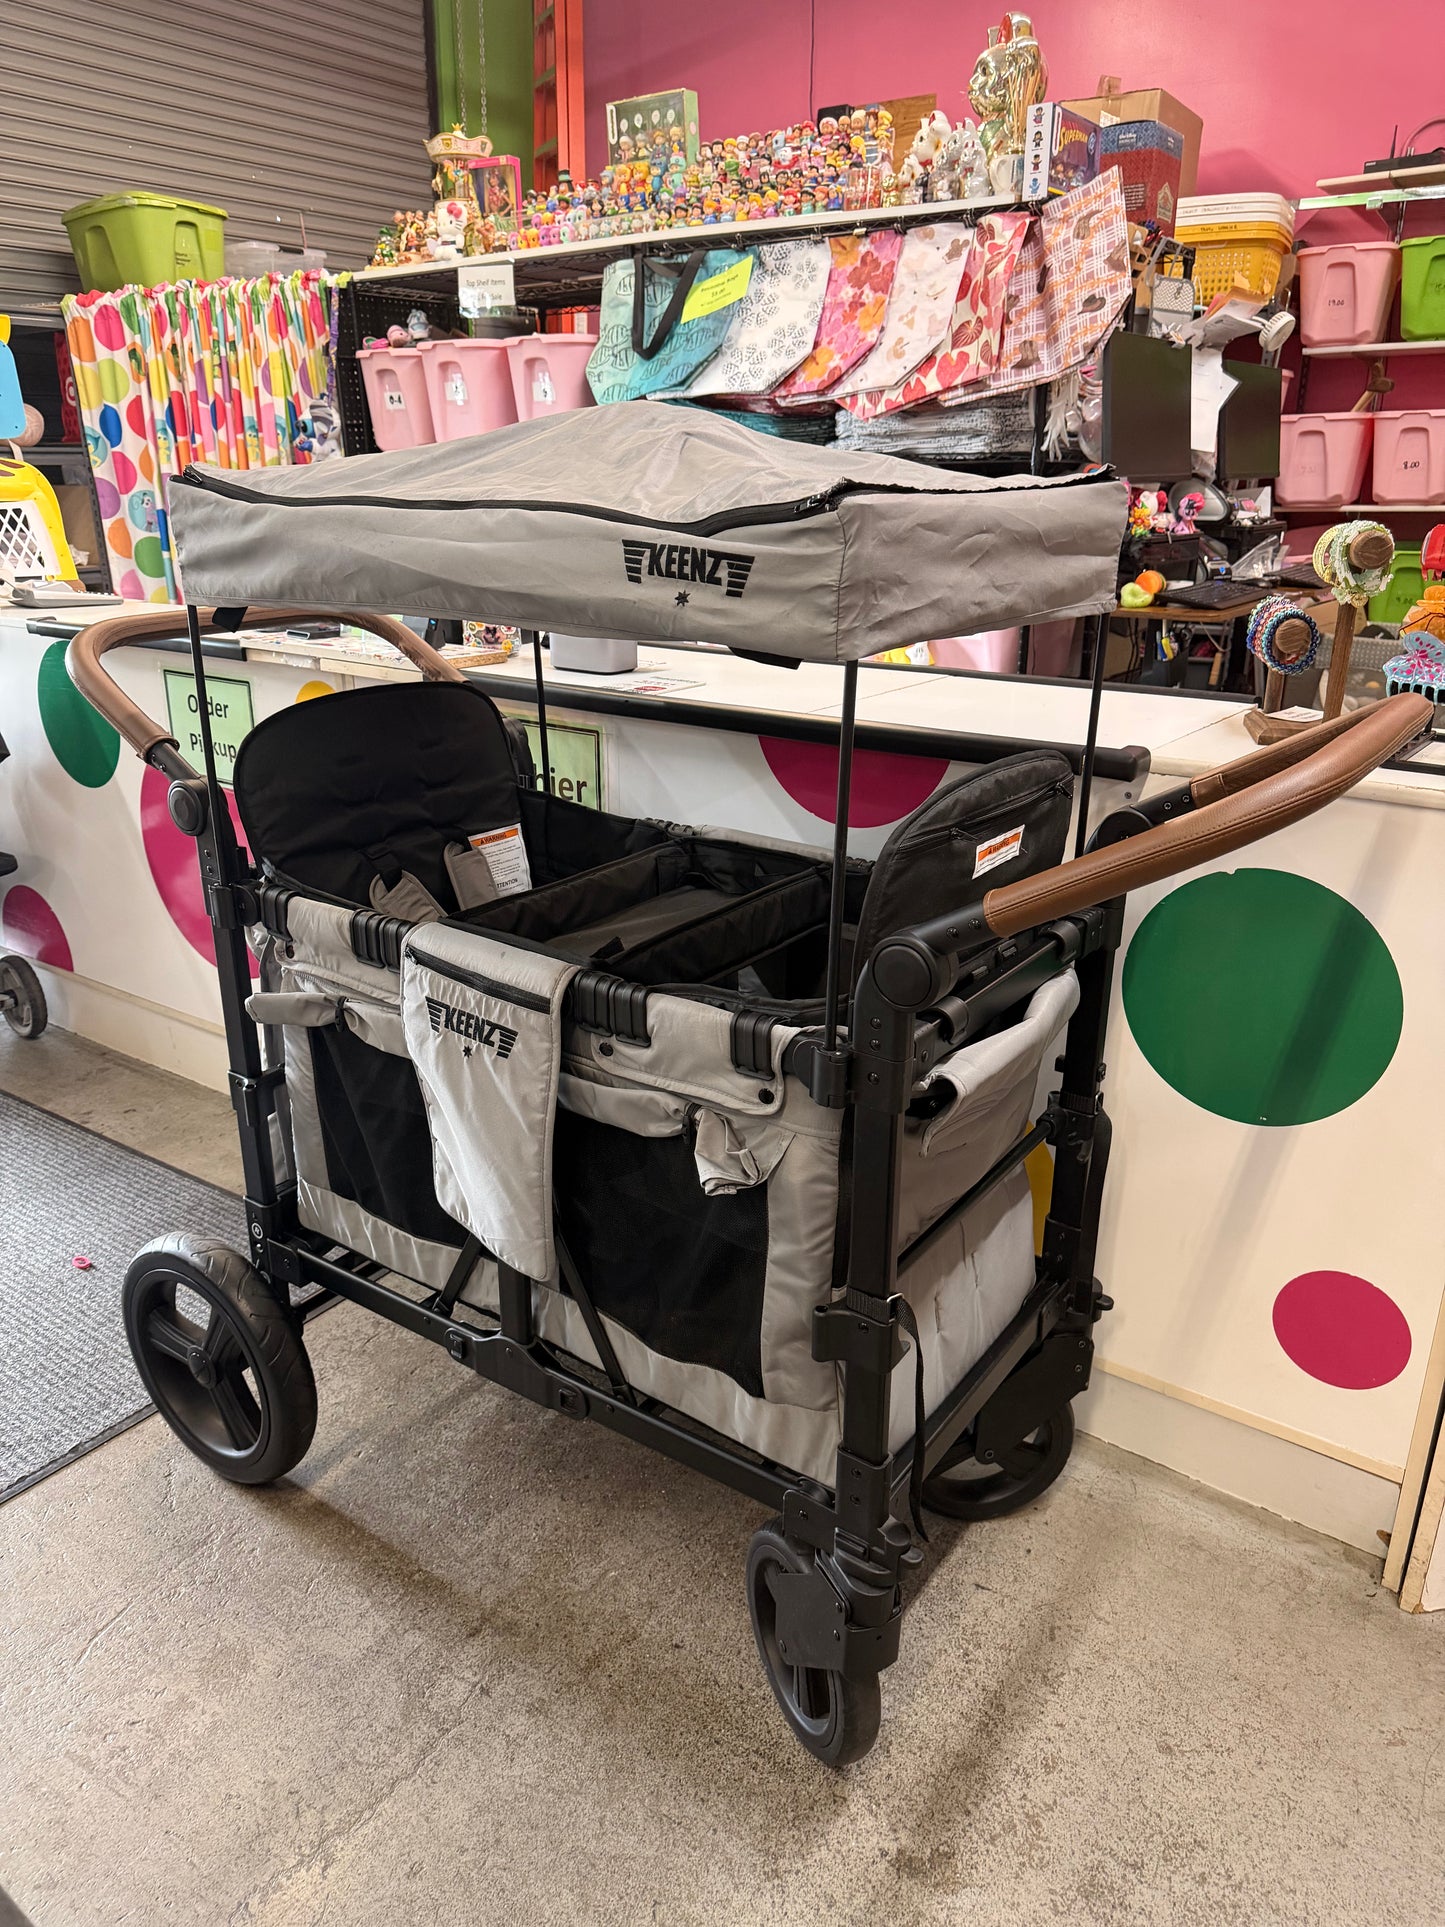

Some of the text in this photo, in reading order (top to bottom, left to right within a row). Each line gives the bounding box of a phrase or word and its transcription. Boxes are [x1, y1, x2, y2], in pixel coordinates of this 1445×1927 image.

[476, 278, 490, 287] Shelf
[187, 694, 229, 719] Oder
[496, 878, 518, 889] TTENTION
